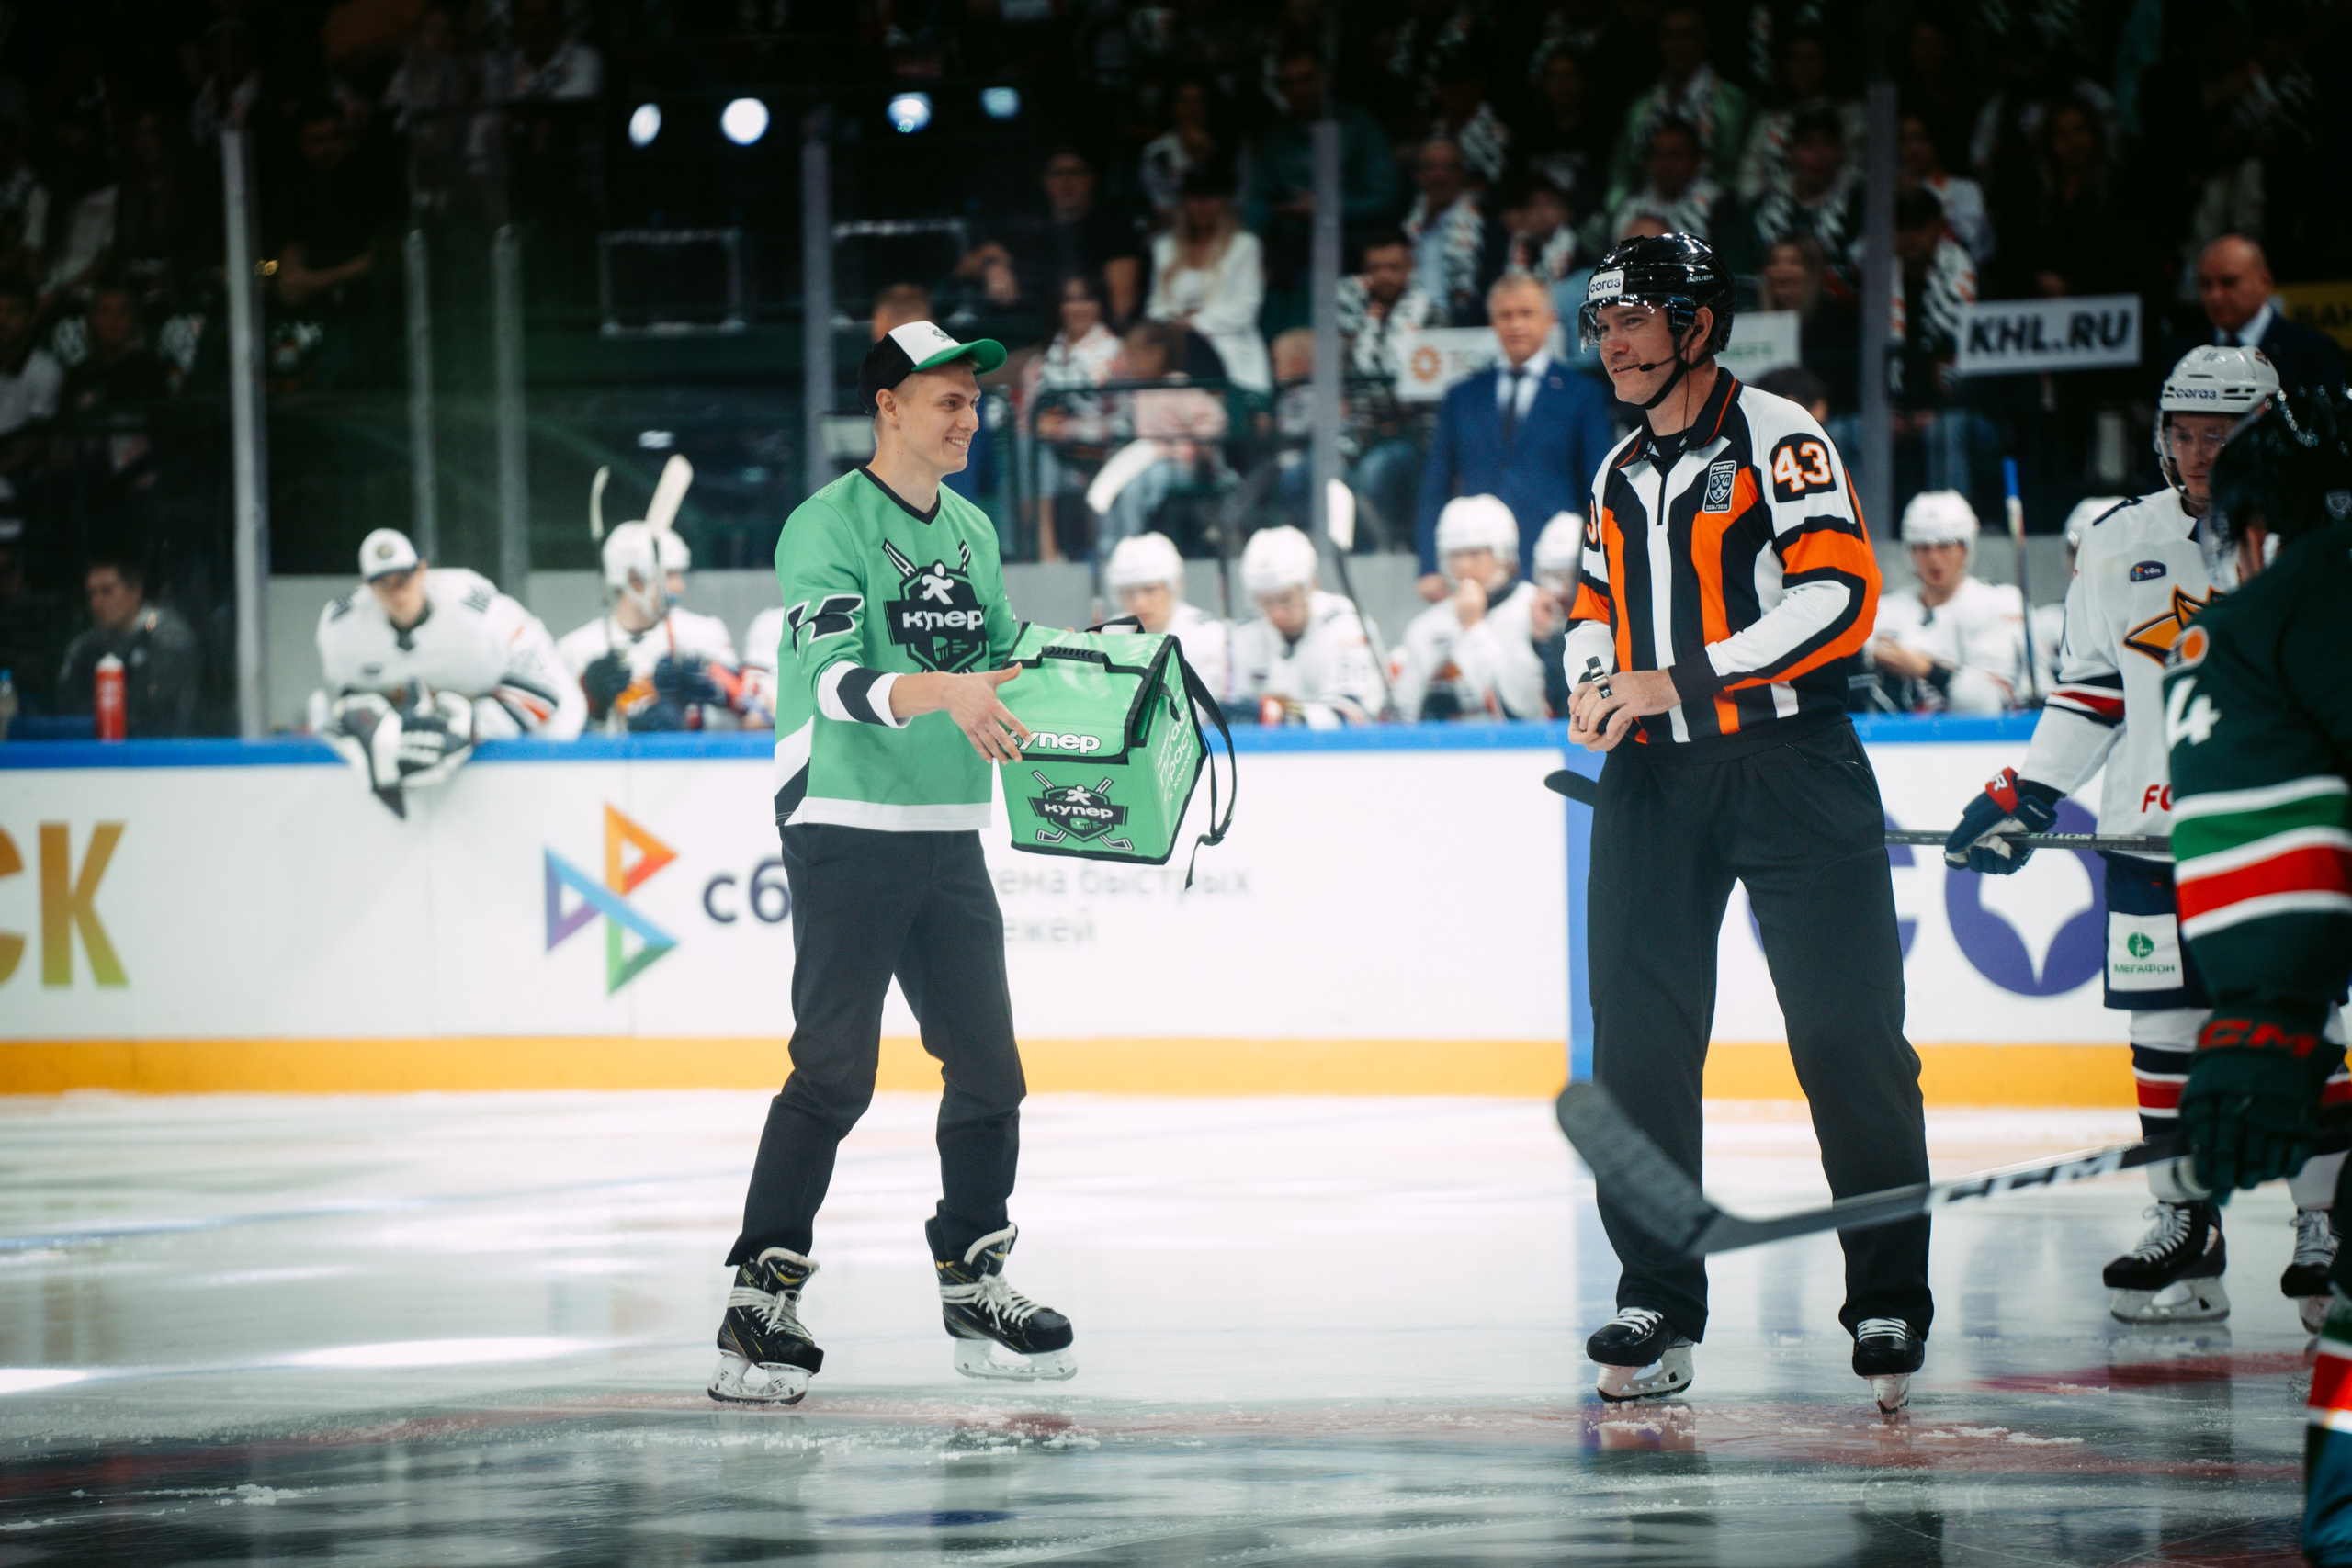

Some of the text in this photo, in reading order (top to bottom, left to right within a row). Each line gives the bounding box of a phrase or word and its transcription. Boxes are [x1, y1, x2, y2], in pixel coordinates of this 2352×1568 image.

[1968, 310, 2132, 353] KHL.RU
[1773, 442, 1832, 493] 43
[1044, 804, 1114, 819] купер
